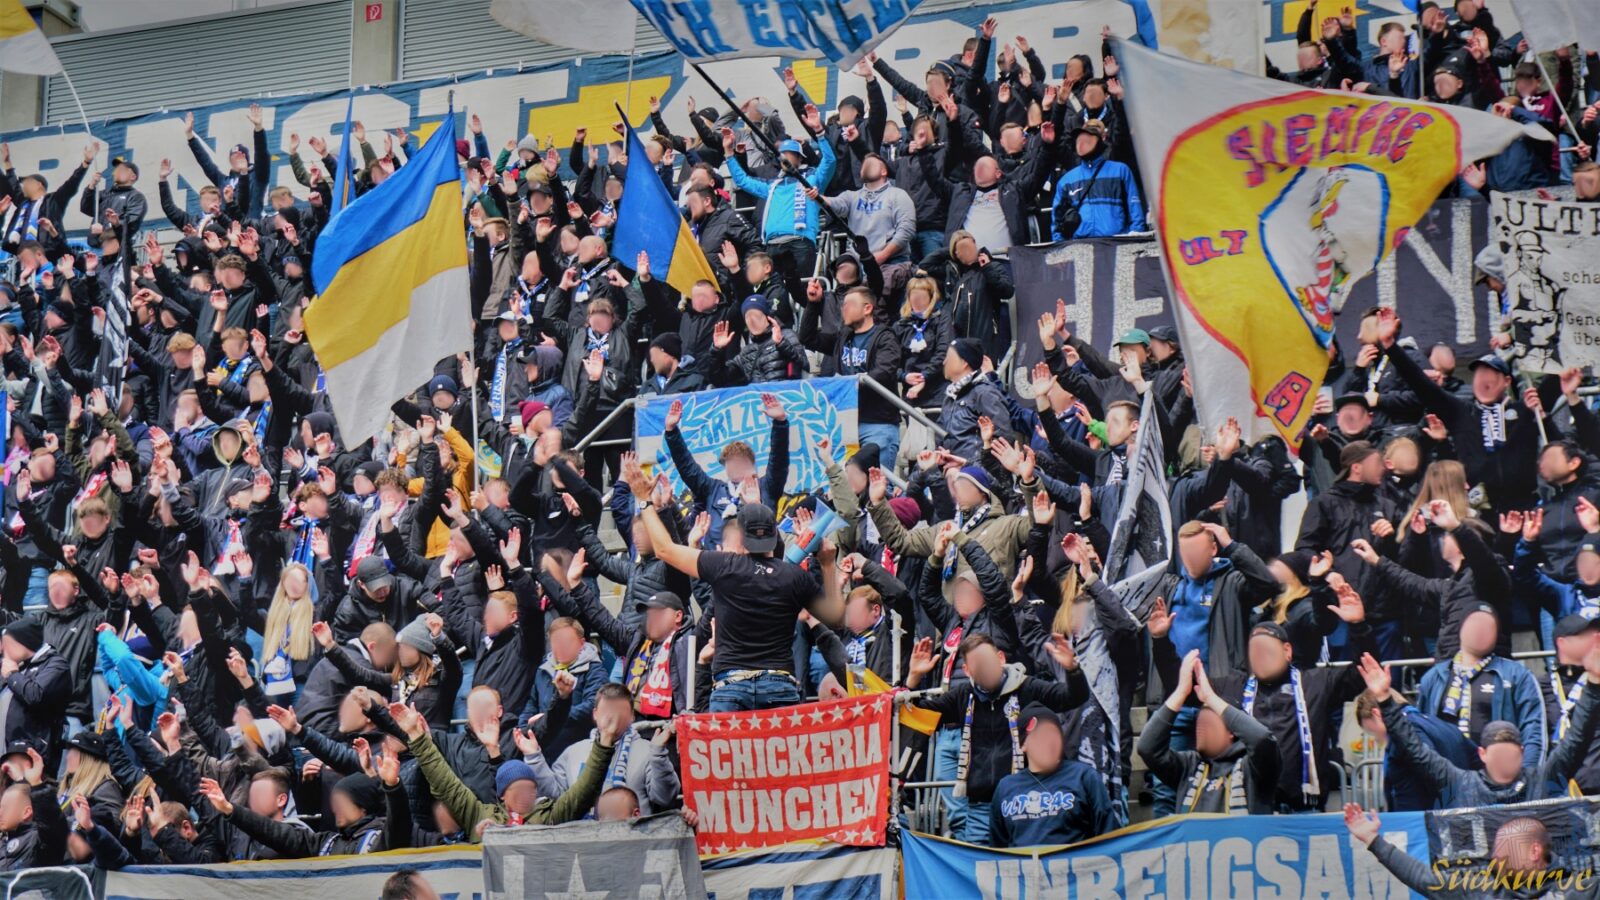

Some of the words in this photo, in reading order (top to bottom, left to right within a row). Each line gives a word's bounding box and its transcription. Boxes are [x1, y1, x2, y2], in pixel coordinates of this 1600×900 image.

[1225, 100, 1434, 188] SIEMPRE
[688, 722, 883, 780] SCHICKERIA
[693, 774, 881, 834] MÜNCHEN
